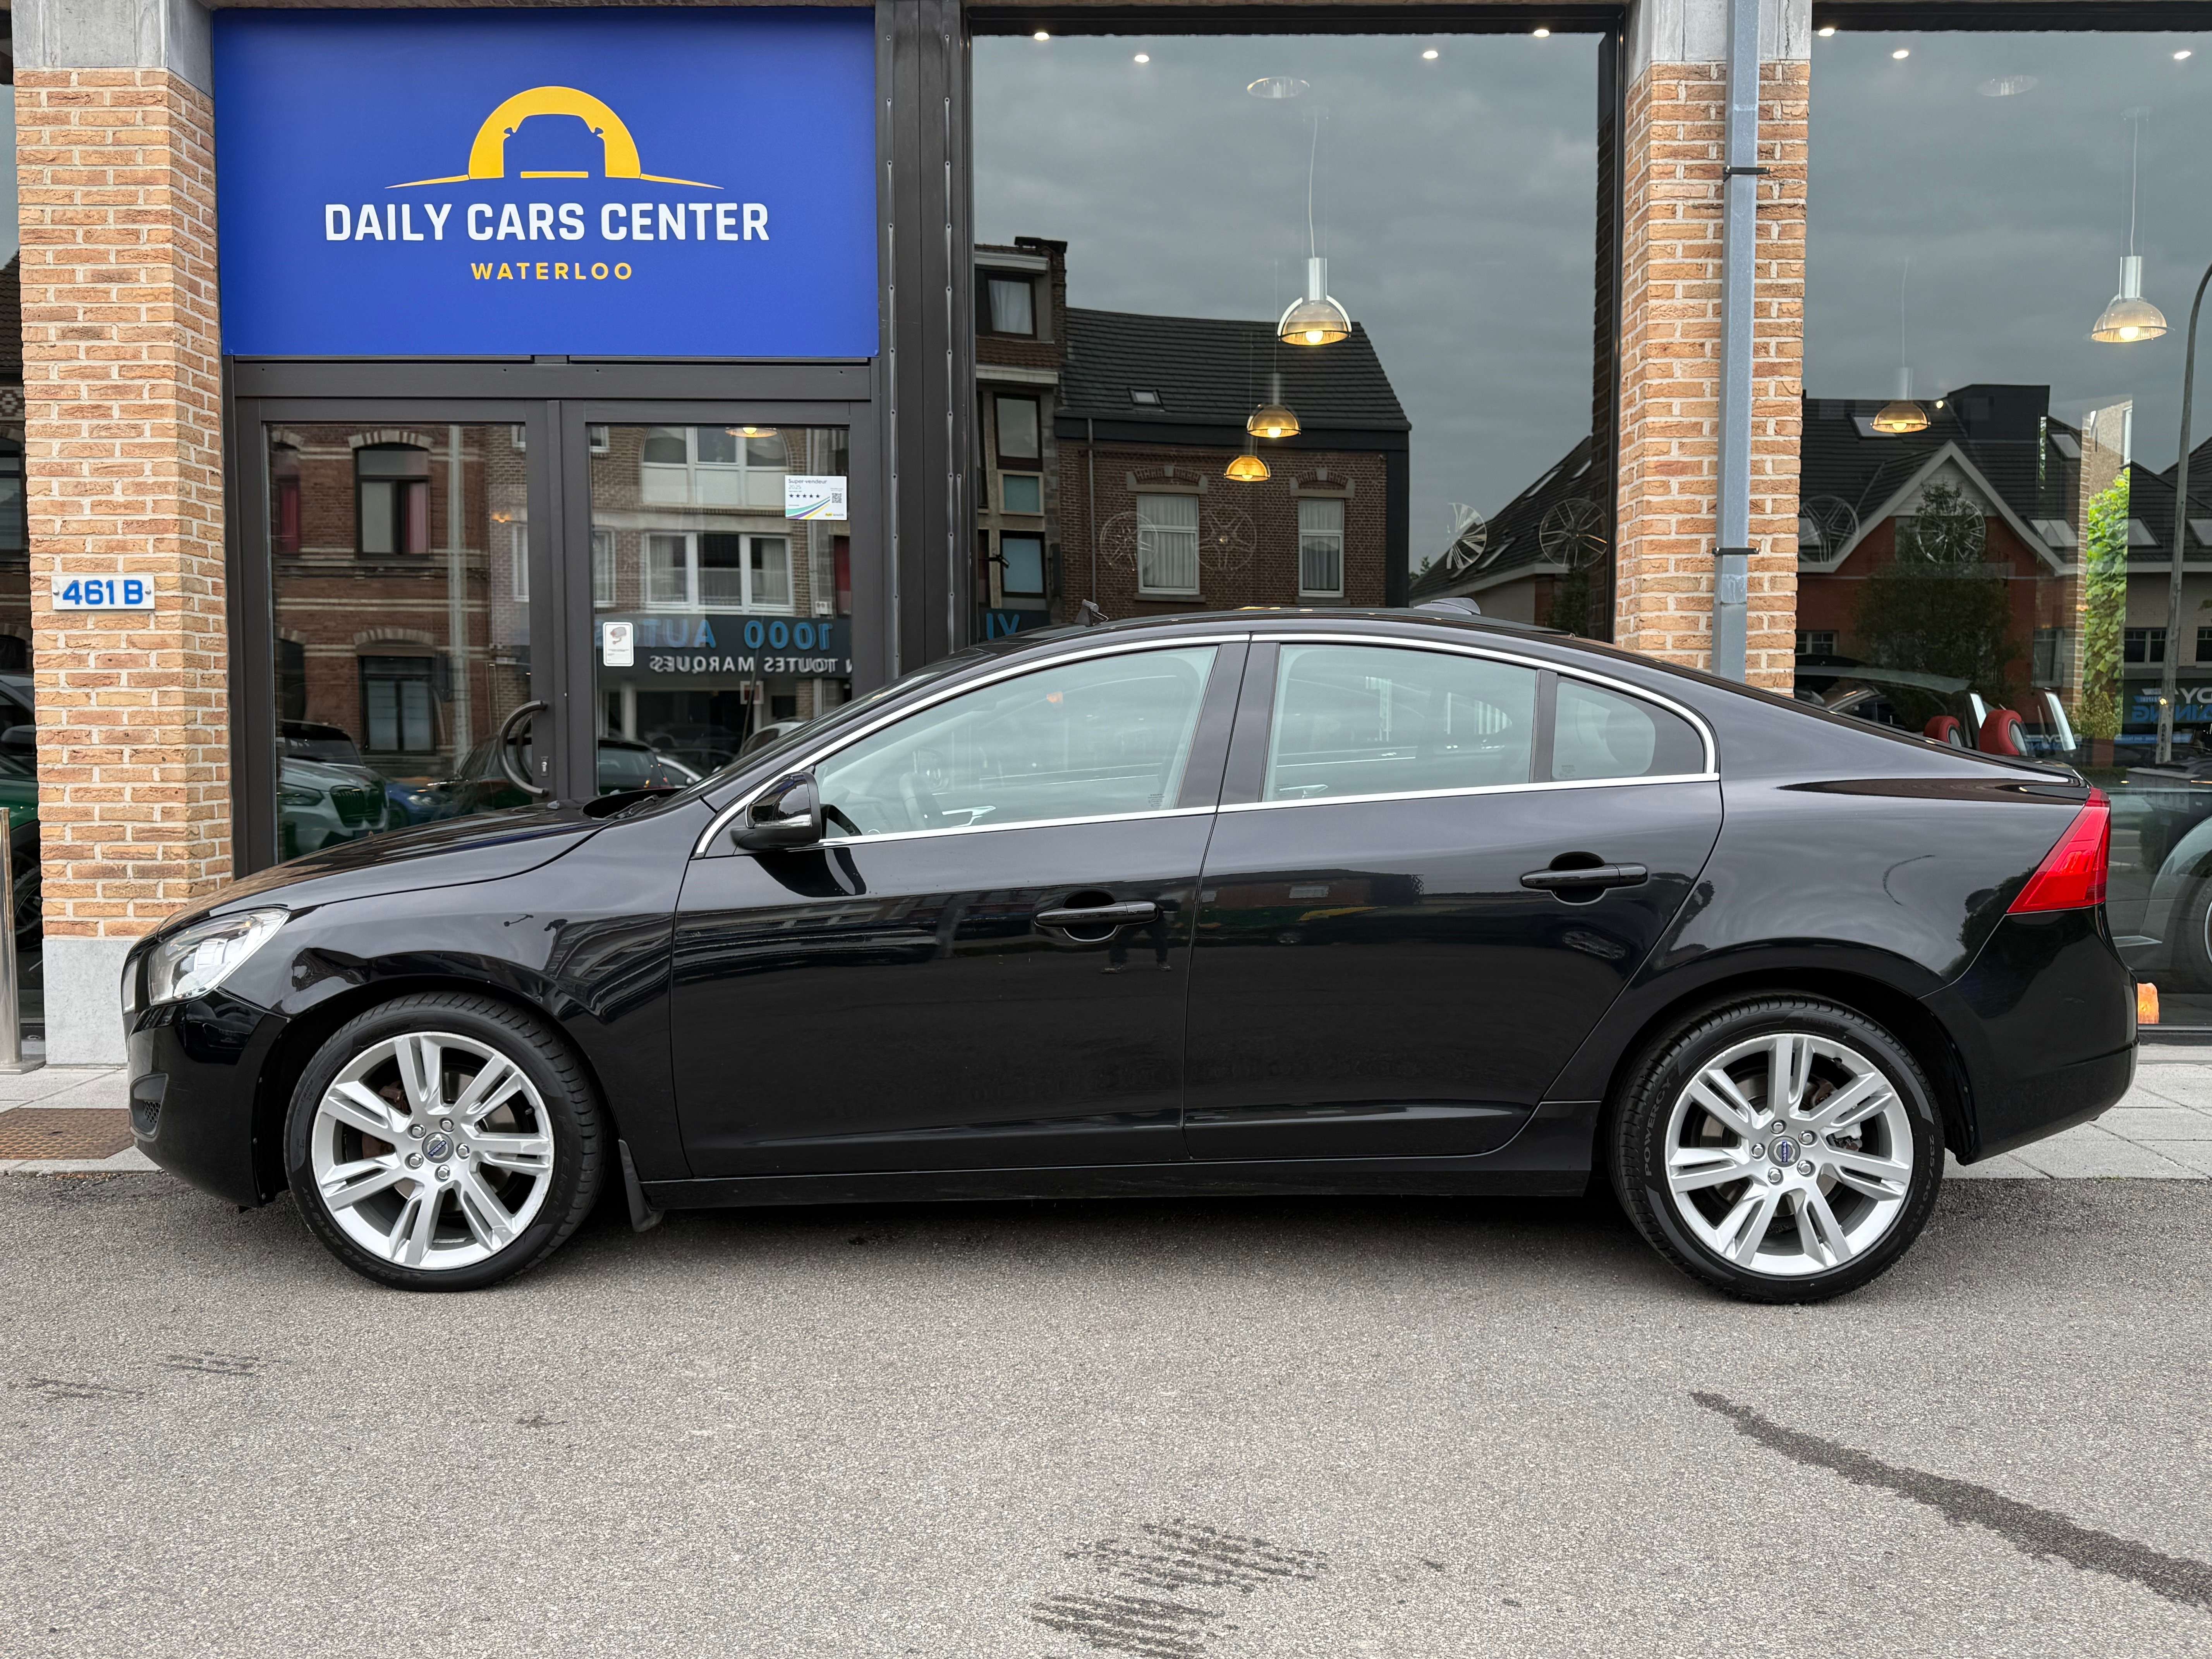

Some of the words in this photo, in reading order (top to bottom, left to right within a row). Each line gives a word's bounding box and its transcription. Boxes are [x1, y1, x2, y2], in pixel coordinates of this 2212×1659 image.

[325, 203, 452, 241] DAILY
[467, 203, 585, 241] CARS
[601, 203, 770, 241] CENTER
[471, 263, 632, 280] WATERLOO
[62, 580, 115, 605] 461
[124, 579, 143, 605] B
